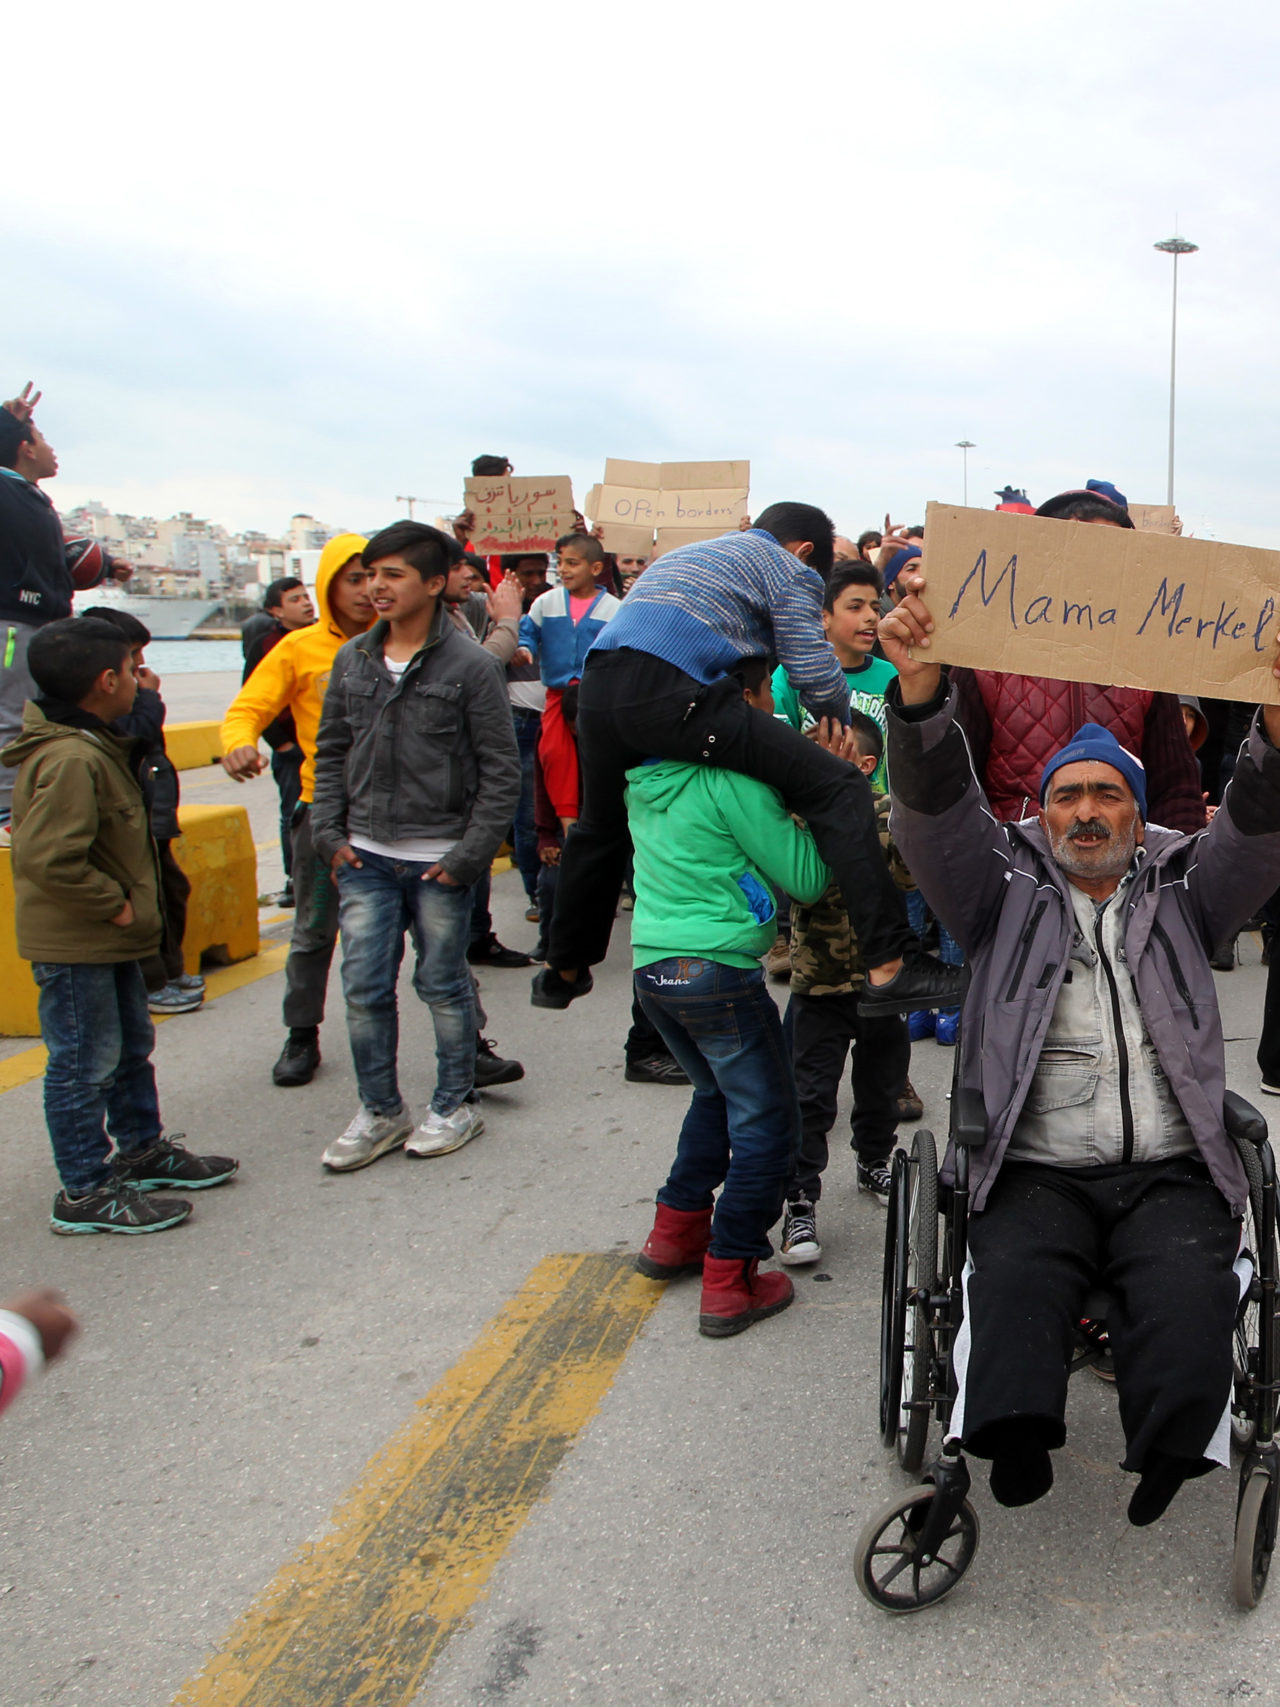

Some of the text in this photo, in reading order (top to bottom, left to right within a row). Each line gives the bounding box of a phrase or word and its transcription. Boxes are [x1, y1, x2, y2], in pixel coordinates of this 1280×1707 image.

[20, 589, 42, 606] NYC
[948, 548, 1275, 652] Mama Merkel
[647, 974, 691, 987] Jeans
